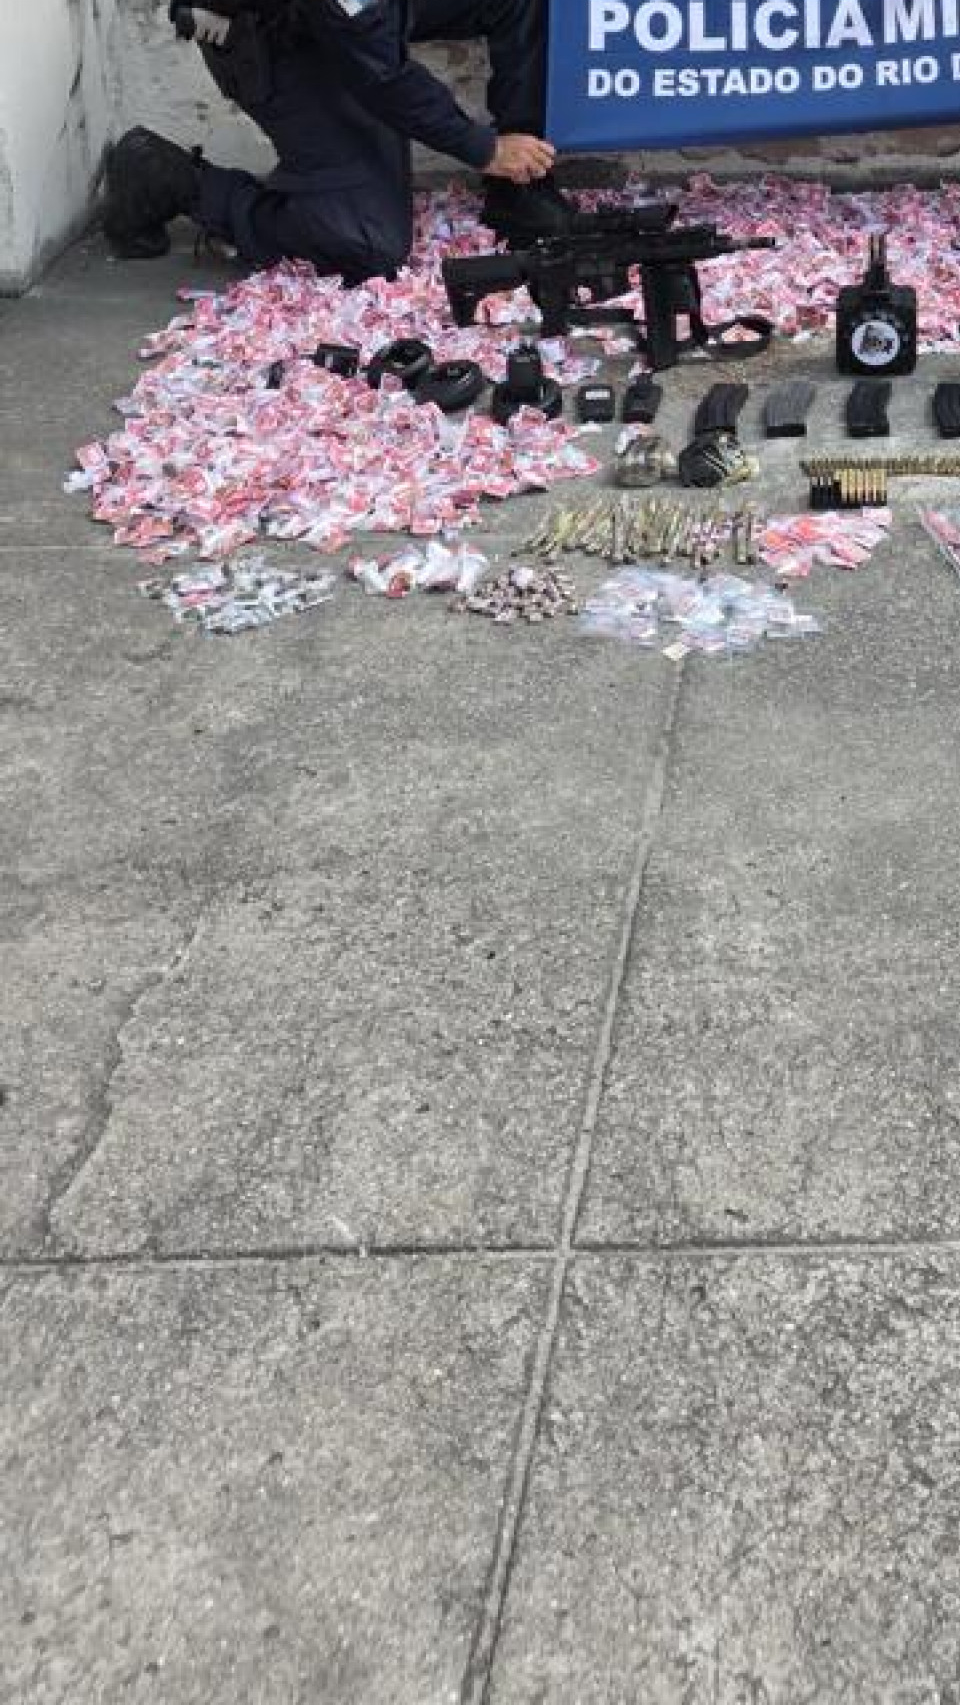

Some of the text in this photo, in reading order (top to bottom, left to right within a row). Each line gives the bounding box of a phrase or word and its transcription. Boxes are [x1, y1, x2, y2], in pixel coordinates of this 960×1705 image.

[587, 68, 640, 97] DO
[653, 66, 800, 97] ESTADO
[812, 65, 864, 92] DO
[875, 55, 939, 86] RIO
